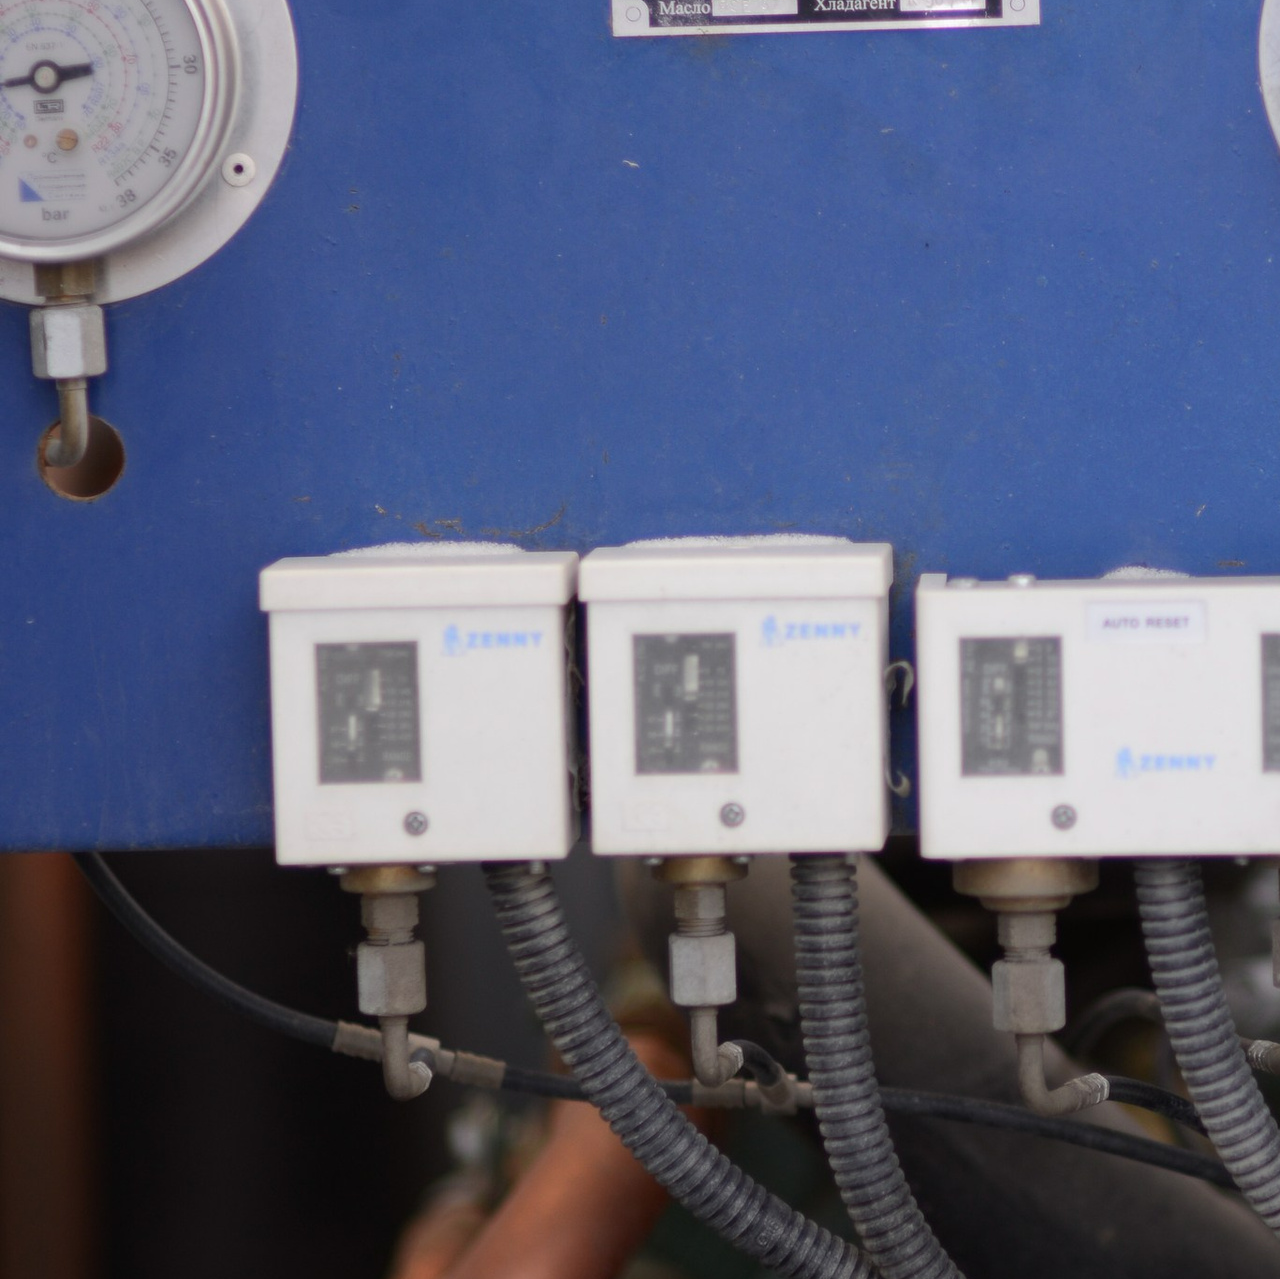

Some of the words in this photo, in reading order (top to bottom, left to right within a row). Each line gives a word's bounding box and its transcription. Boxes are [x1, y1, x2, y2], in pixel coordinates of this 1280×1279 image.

[659, 0, 711, 16] Масло
[183, 54, 199, 76] 30
[158, 146, 178, 168] 35
[115, 188, 137, 209] 38
[41, 207, 70, 222] bar
[785, 622, 861, 640] ZENNY
[1102, 616, 1140, 630] AUTO
[1145, 615, 1191, 629] RESET
[466, 631, 544, 649] ZENNY
[1137, 753, 1217, 772] ZENNY
